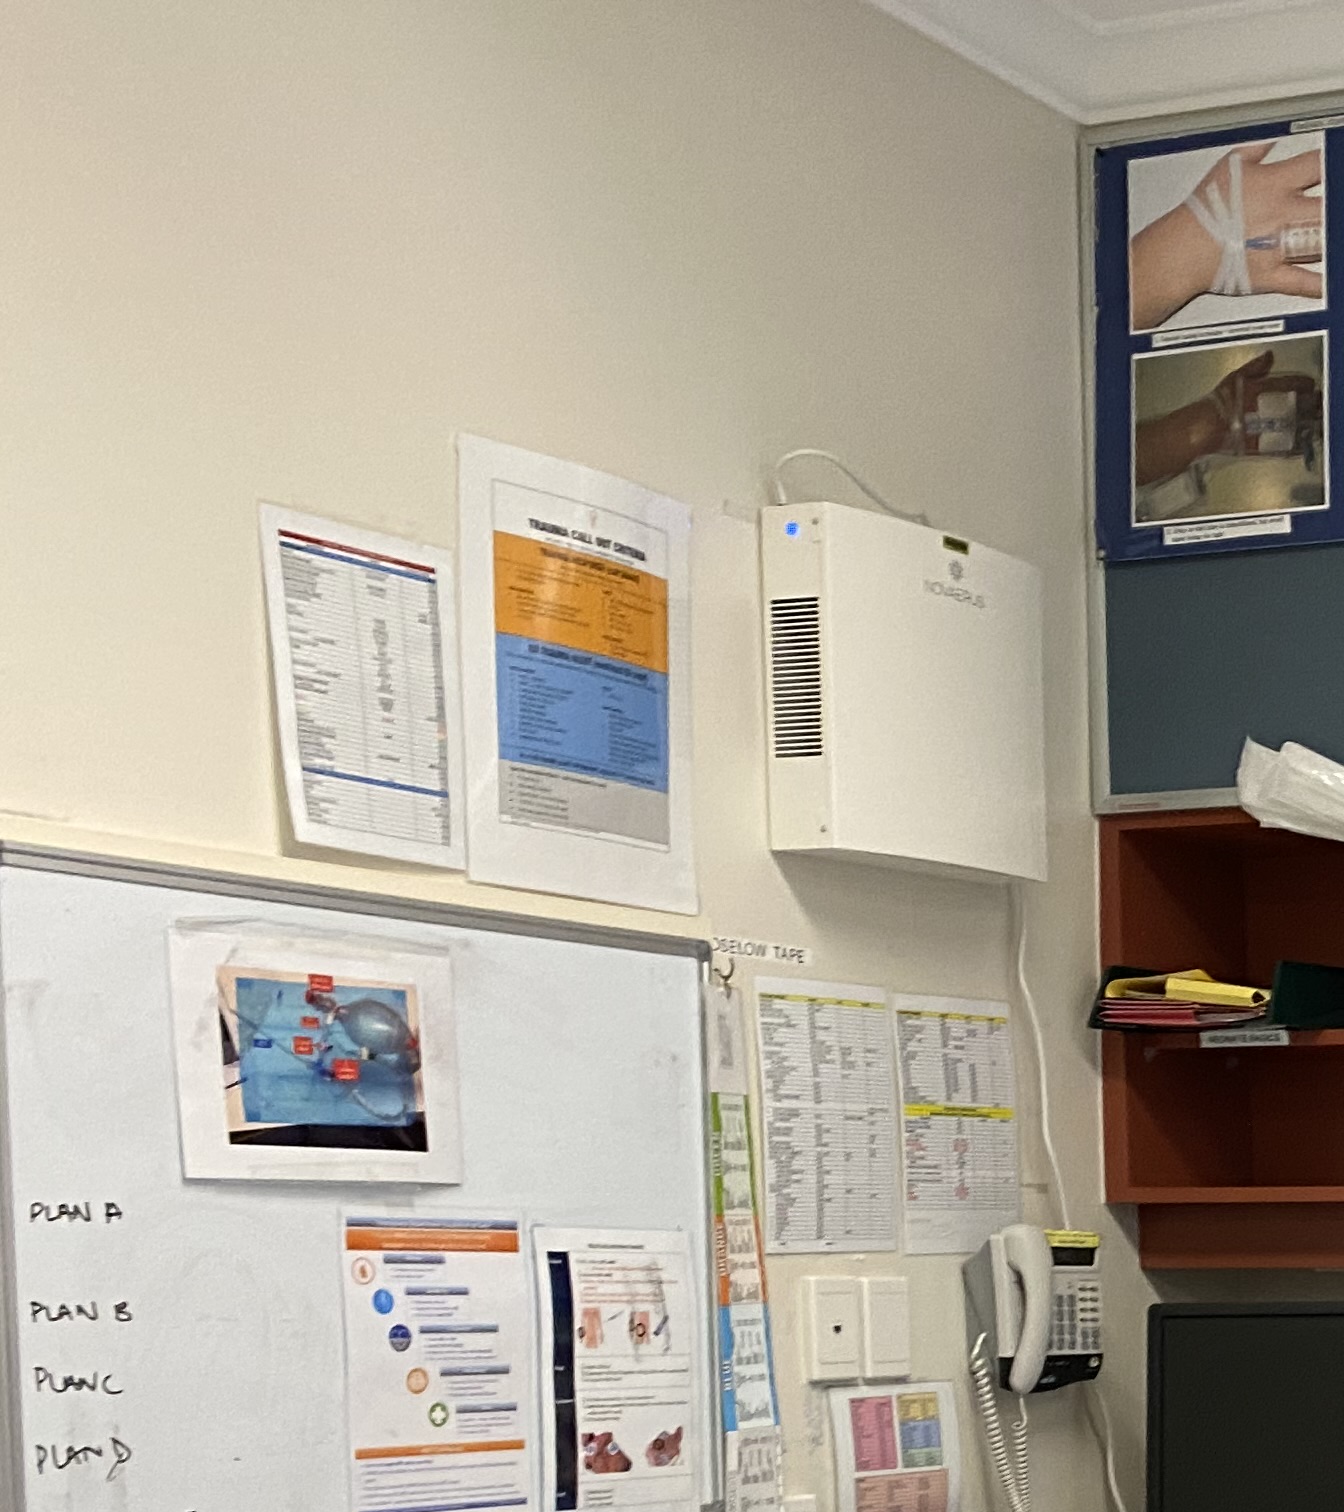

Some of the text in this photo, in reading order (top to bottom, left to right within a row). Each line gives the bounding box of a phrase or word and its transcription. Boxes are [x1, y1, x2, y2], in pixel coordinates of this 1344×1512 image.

[773, 946, 804, 964] TAPE
[30, 1202, 122, 1223] PLAN A
[30, 1301, 132, 1322] PLAN B
[35, 1445, 103, 1475] PLAN
